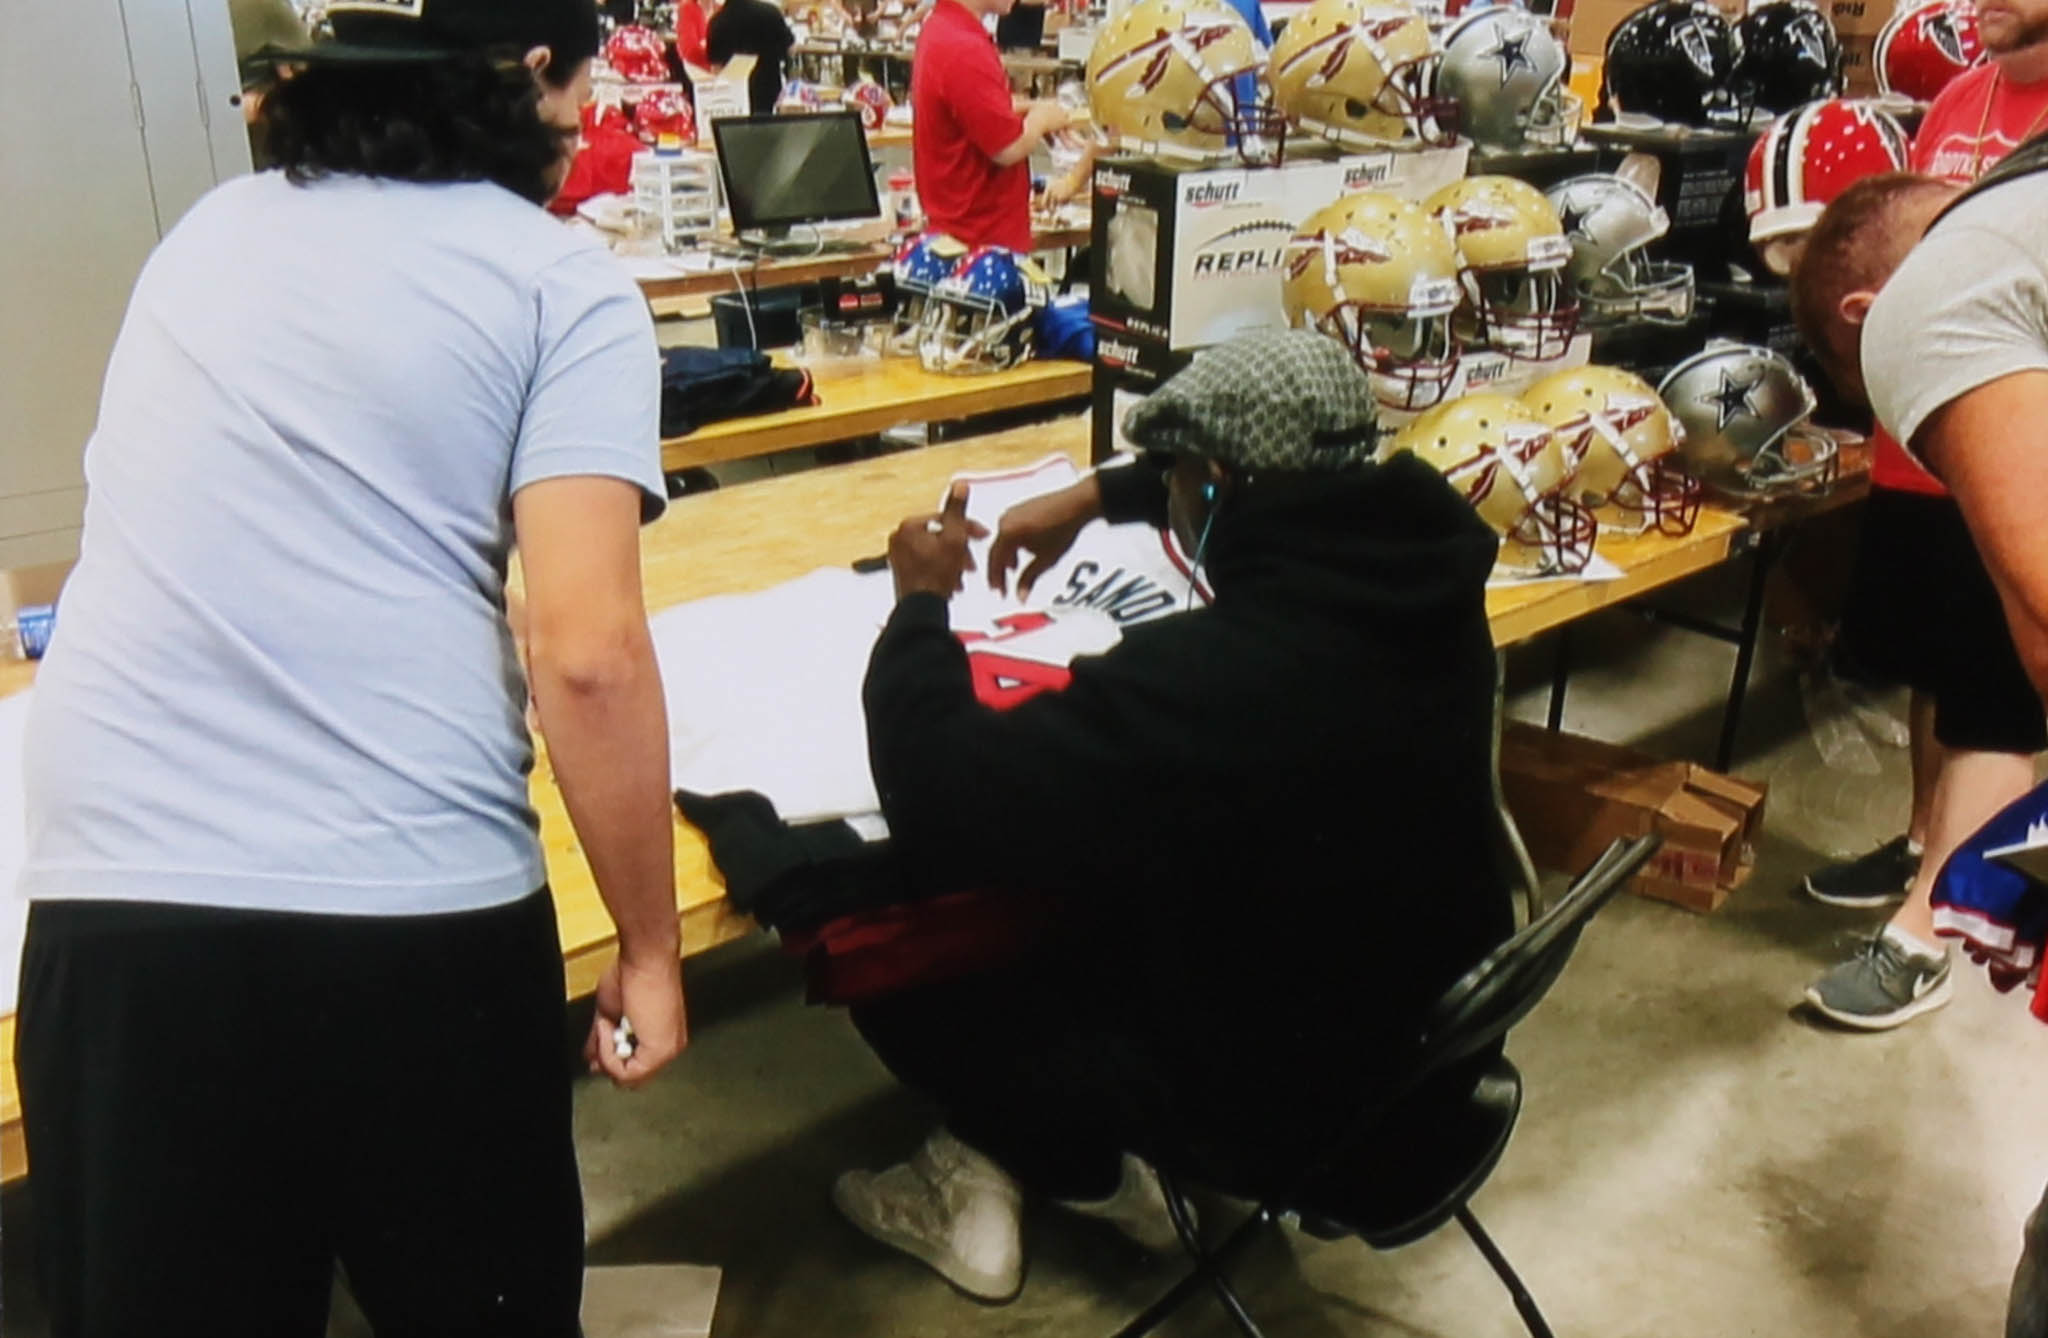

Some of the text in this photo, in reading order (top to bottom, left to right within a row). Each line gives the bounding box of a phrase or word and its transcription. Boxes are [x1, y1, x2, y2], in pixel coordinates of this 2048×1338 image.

[1095, 167, 1131, 191] schutt
[1344, 163, 1387, 184] schutt
[1185, 180, 1240, 203] schutt
[1194, 248, 1282, 273] REPLI
[1097, 338, 1139, 364] schutt
[1466, 361, 1505, 382] chutt
